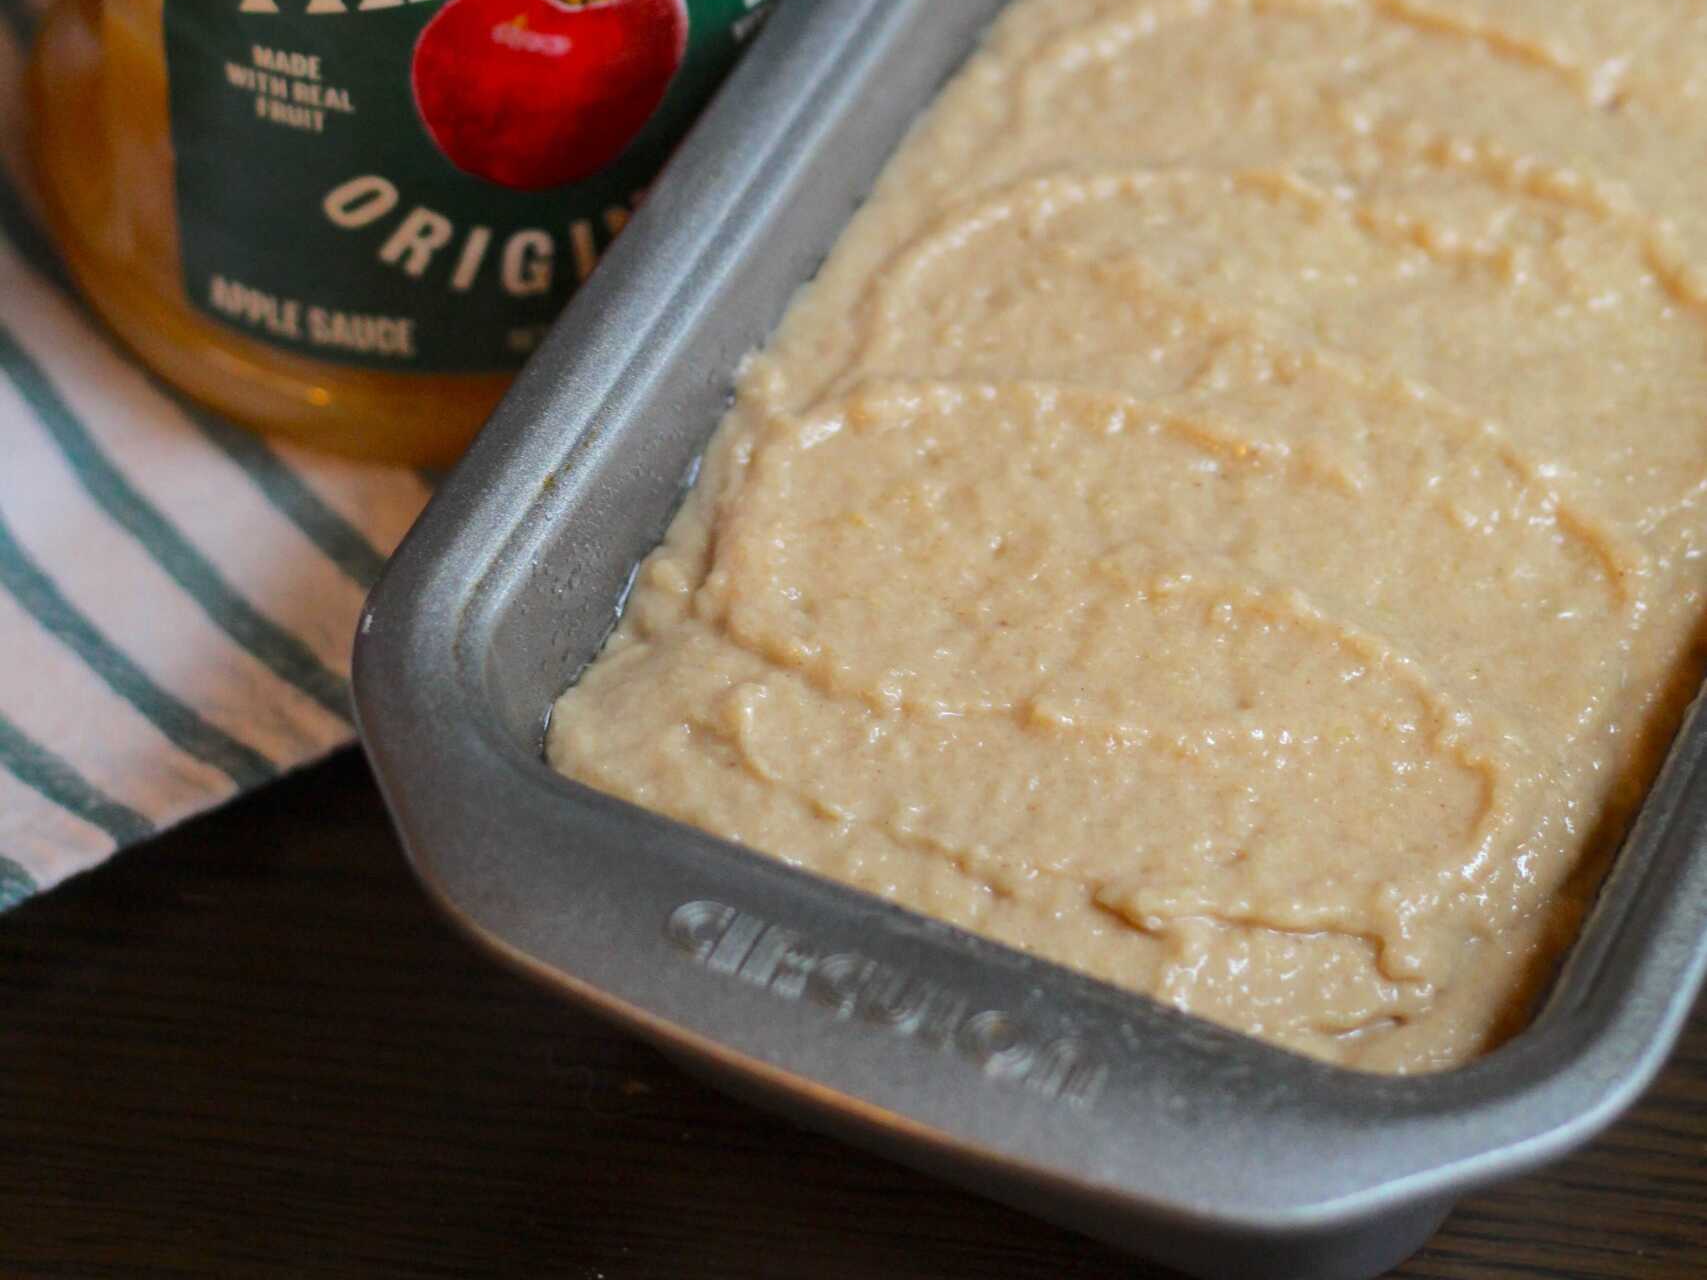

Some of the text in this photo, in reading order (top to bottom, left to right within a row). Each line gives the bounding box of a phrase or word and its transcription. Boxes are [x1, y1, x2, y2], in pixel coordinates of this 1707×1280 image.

[251, 44, 321, 81] MADE
[224, 61, 356, 115] WITH REAL
[255, 95, 324, 134] FRUIT
[210, 274, 416, 358] APPLE SAUCE
